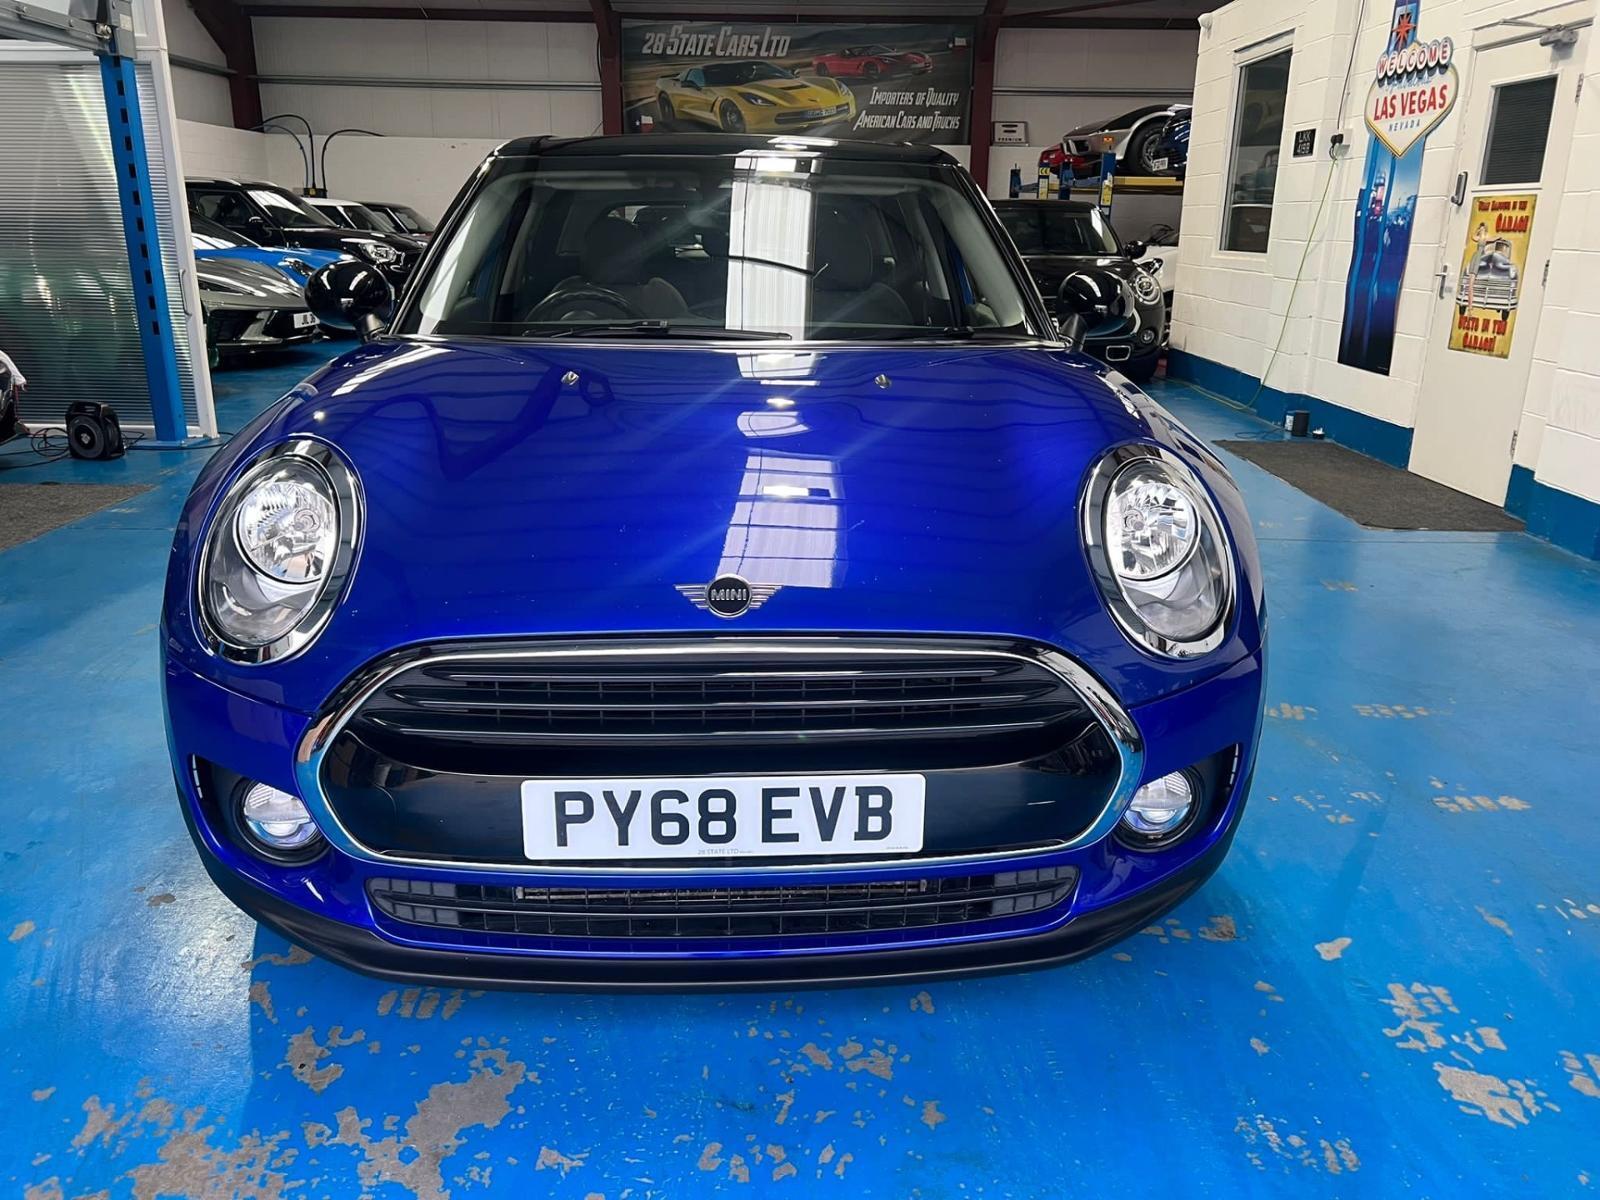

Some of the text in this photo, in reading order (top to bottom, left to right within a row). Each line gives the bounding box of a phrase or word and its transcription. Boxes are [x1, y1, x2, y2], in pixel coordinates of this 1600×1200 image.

[642, 32, 666, 54] 28
[1378, 39, 1450, 75] WELCOME
[869, 86, 960, 108] IMPORTERS OF QUALITY
[1374, 84, 1448, 121] LAS VEGAS
[852, 110, 896, 131] AMERICAN
[916, 115, 933, 129] AND
[1388, 119, 1421, 132] NEVADA
[710, 588, 748, 601] MINI
[554, 785, 894, 847] PY68 EVB
